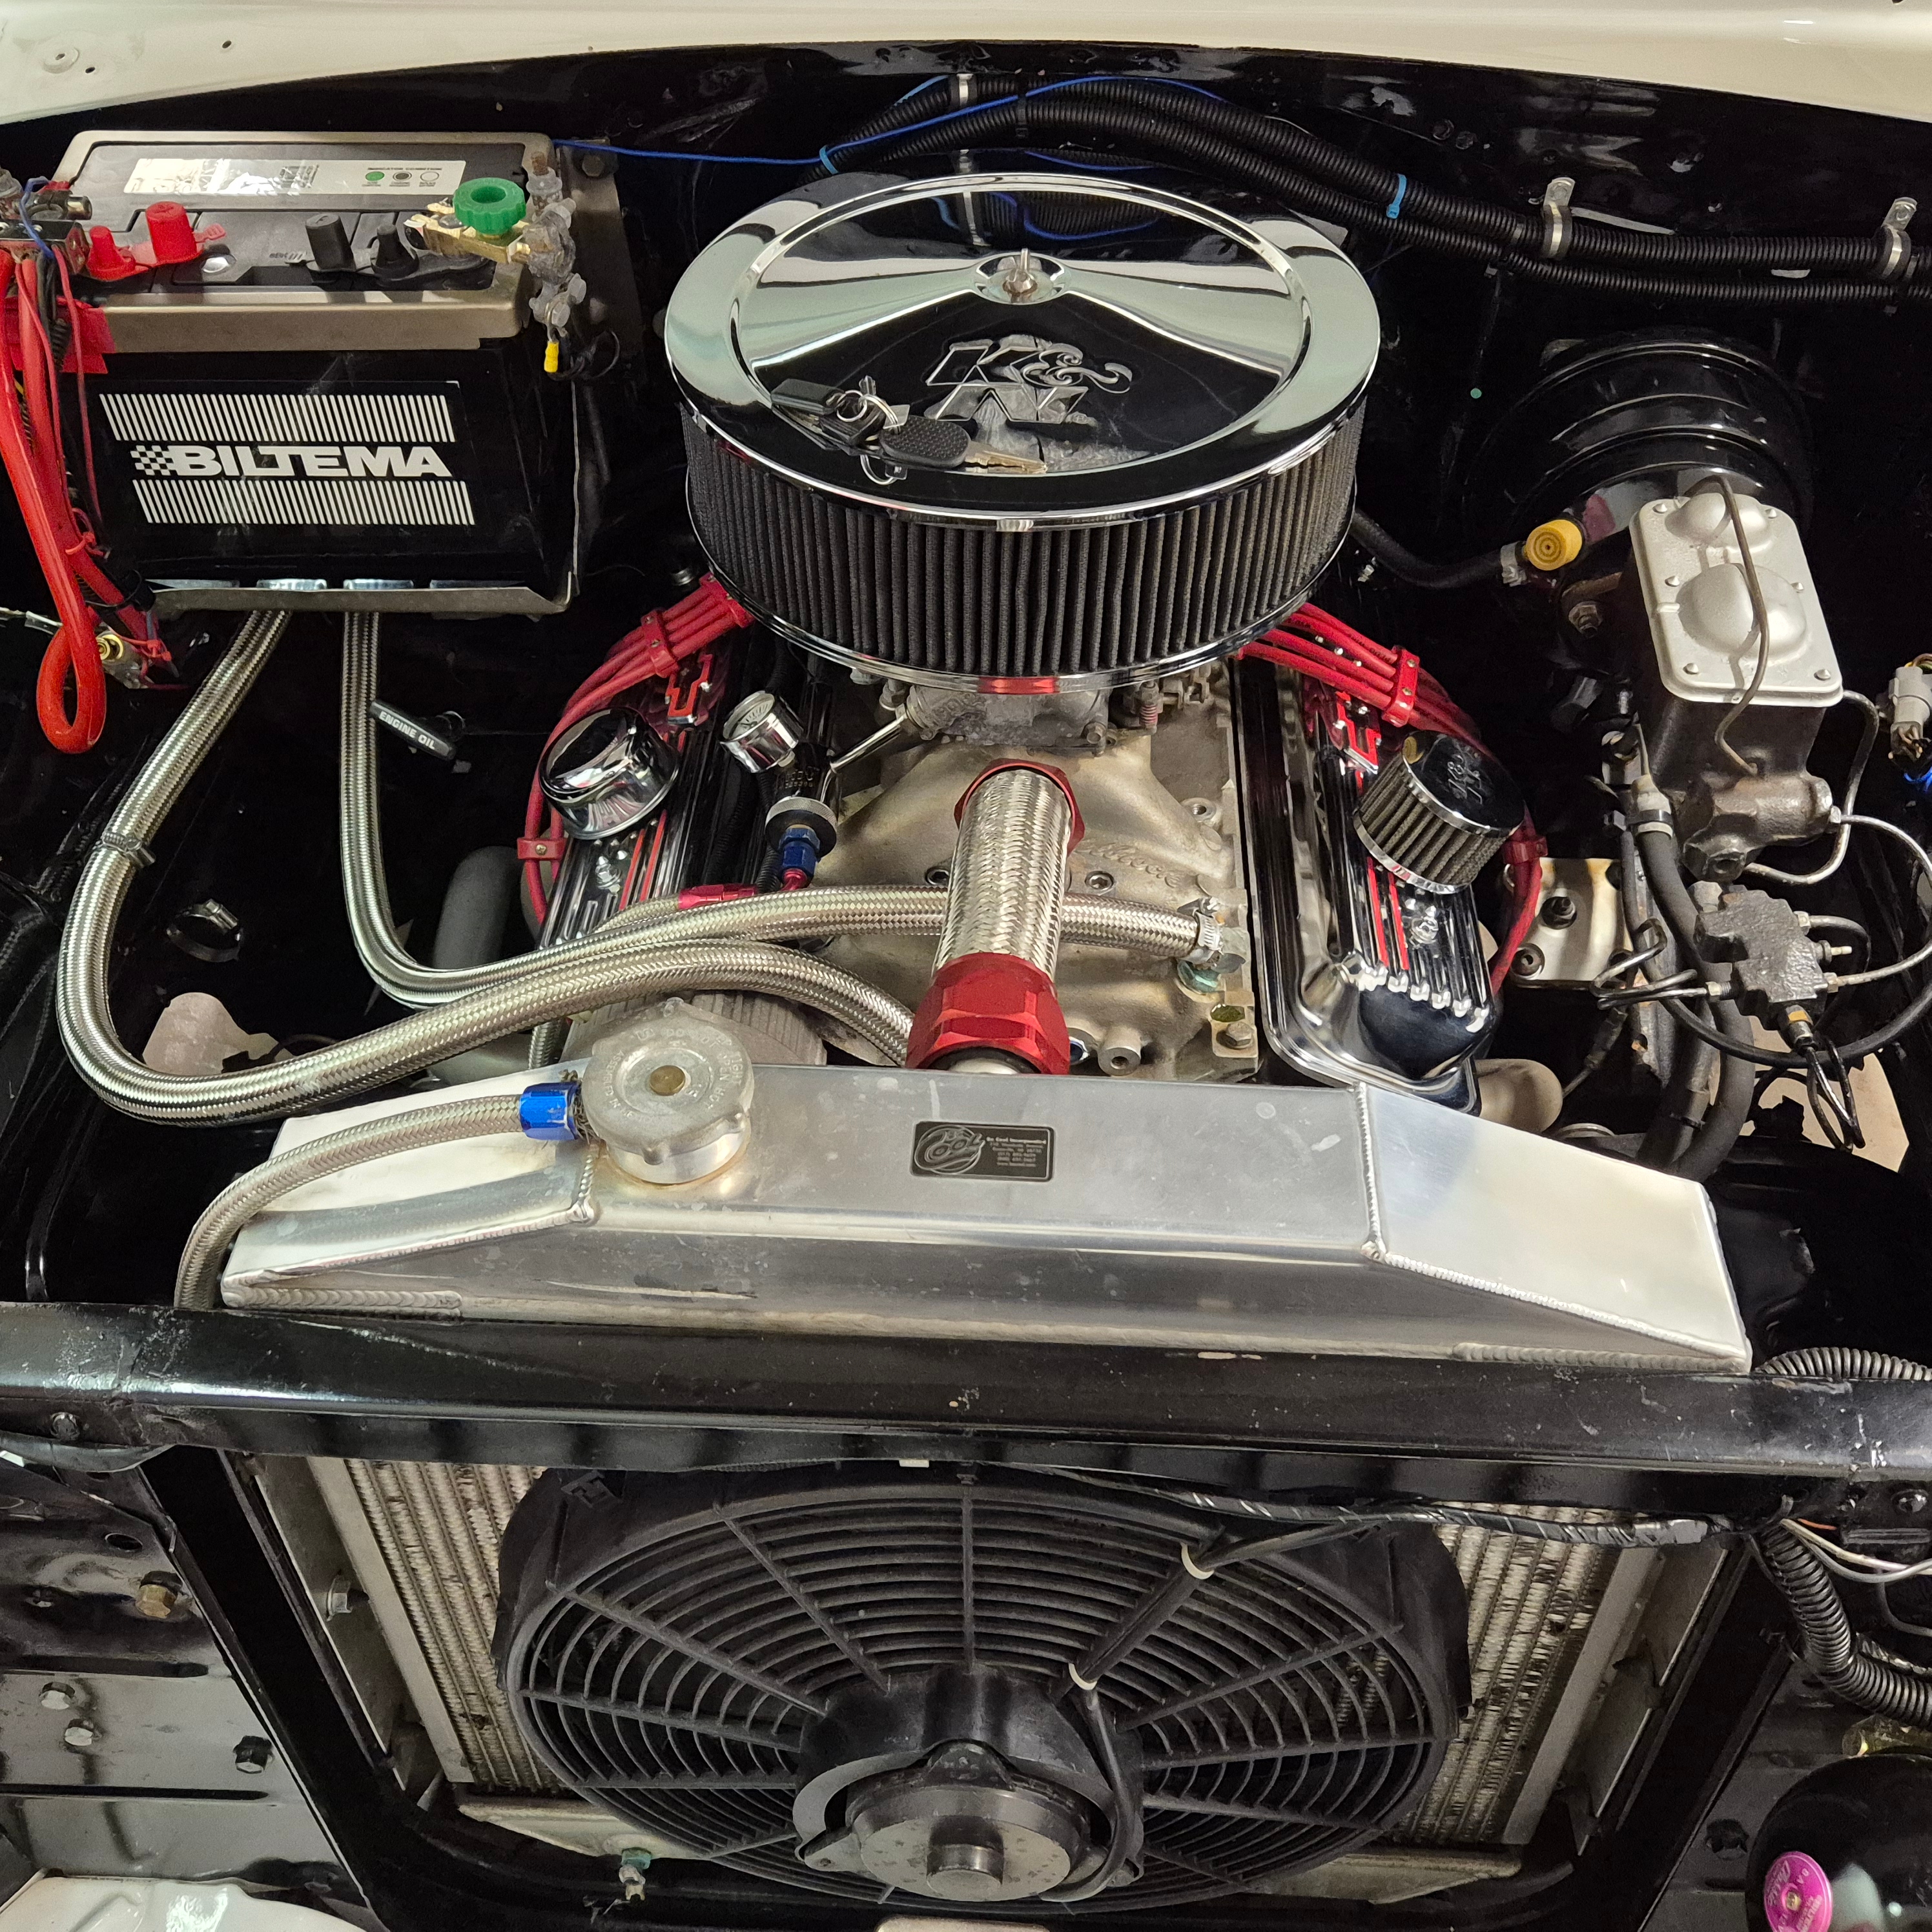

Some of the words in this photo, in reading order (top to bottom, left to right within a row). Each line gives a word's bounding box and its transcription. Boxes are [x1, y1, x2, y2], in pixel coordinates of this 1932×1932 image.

[167, 445, 452, 477] BILTEMA
[379, 710, 417, 739] ENGINE
[418, 734, 435, 750] OIL
